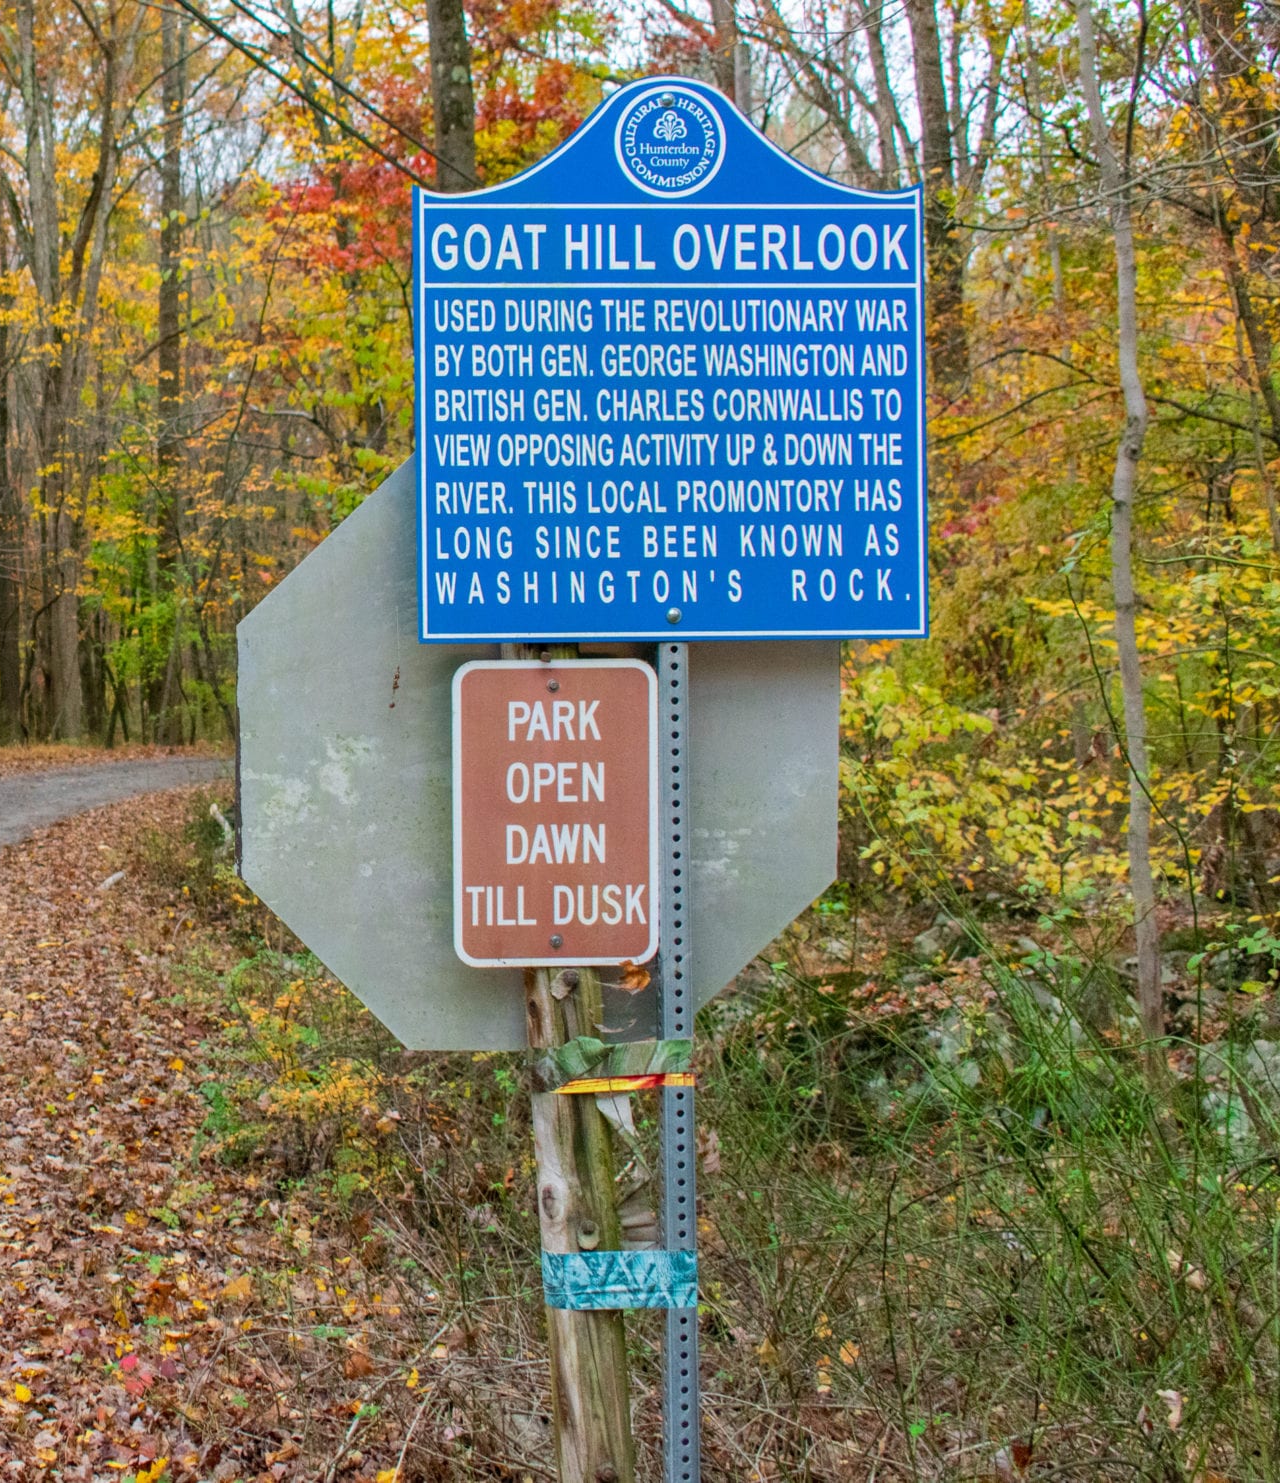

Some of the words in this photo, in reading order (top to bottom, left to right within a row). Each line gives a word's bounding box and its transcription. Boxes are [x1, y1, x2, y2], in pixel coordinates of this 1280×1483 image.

[678, 98, 715, 157] HERITAGE
[640, 143, 699, 154] Hunterdon
[650, 156, 689, 168] County
[631, 157, 710, 187] COMMISSION
[432, 224, 546, 270] GOAT
[566, 224, 655, 269] HILL
[674, 224, 908, 270] OVERLOOK
[435, 300, 495, 331] USED
[505, 300, 592, 331] DURING
[601, 300, 645, 331] THE
[655, 300, 848, 331] REVOLUTIONARY
[856, 300, 907, 331] WAR
[435, 345, 464, 376] BY
[472, 345, 532, 376] BOTH
[542, 345, 593, 376] GEN.
[602, 344, 697, 376] GEORGE
[704, 344, 854, 376] WASHINGTON
[862, 345, 907, 376] AND
[436, 389, 524, 421] BRITISH
[534, 389, 587, 421] GEN.
[597, 389, 704, 421] CHARLES
[714, 389, 863, 421] CORNWALLIS
[872, 389, 901, 420] TO
[435, 435, 490, 466] VIEW
[498, 434, 613, 466] OPPOSING
[621, 434, 719, 466] ACTIVITY
[727, 434, 755, 465] UP
[764, 434, 777, 465] &
[786, 434, 852, 465] DOWN
[860, 434, 902, 465] THE
[436, 482, 513, 514] RIVER.
[524, 481, 576, 513] THIS
[588, 481, 666, 513] LOCAL
[678, 480, 843, 512] PROMONTORY
[856, 479, 902, 511] HAS
[437, 527, 512, 559] LONG
[536, 526, 620, 558] SINCE
[644, 526, 716, 557] BEEN
[741, 525, 842, 556] KNOWN
[866, 524, 899, 556] AS
[436, 570, 742, 604] WASHINGTON'S
[793, 569, 910, 601] ROCK.
[509, 701, 601, 741] PARK
[507, 762, 604, 803] OPEN
[506, 824, 605, 864] DAWN
[466, 886, 536, 926] TILL
[554, 885, 646, 925] DUSK
